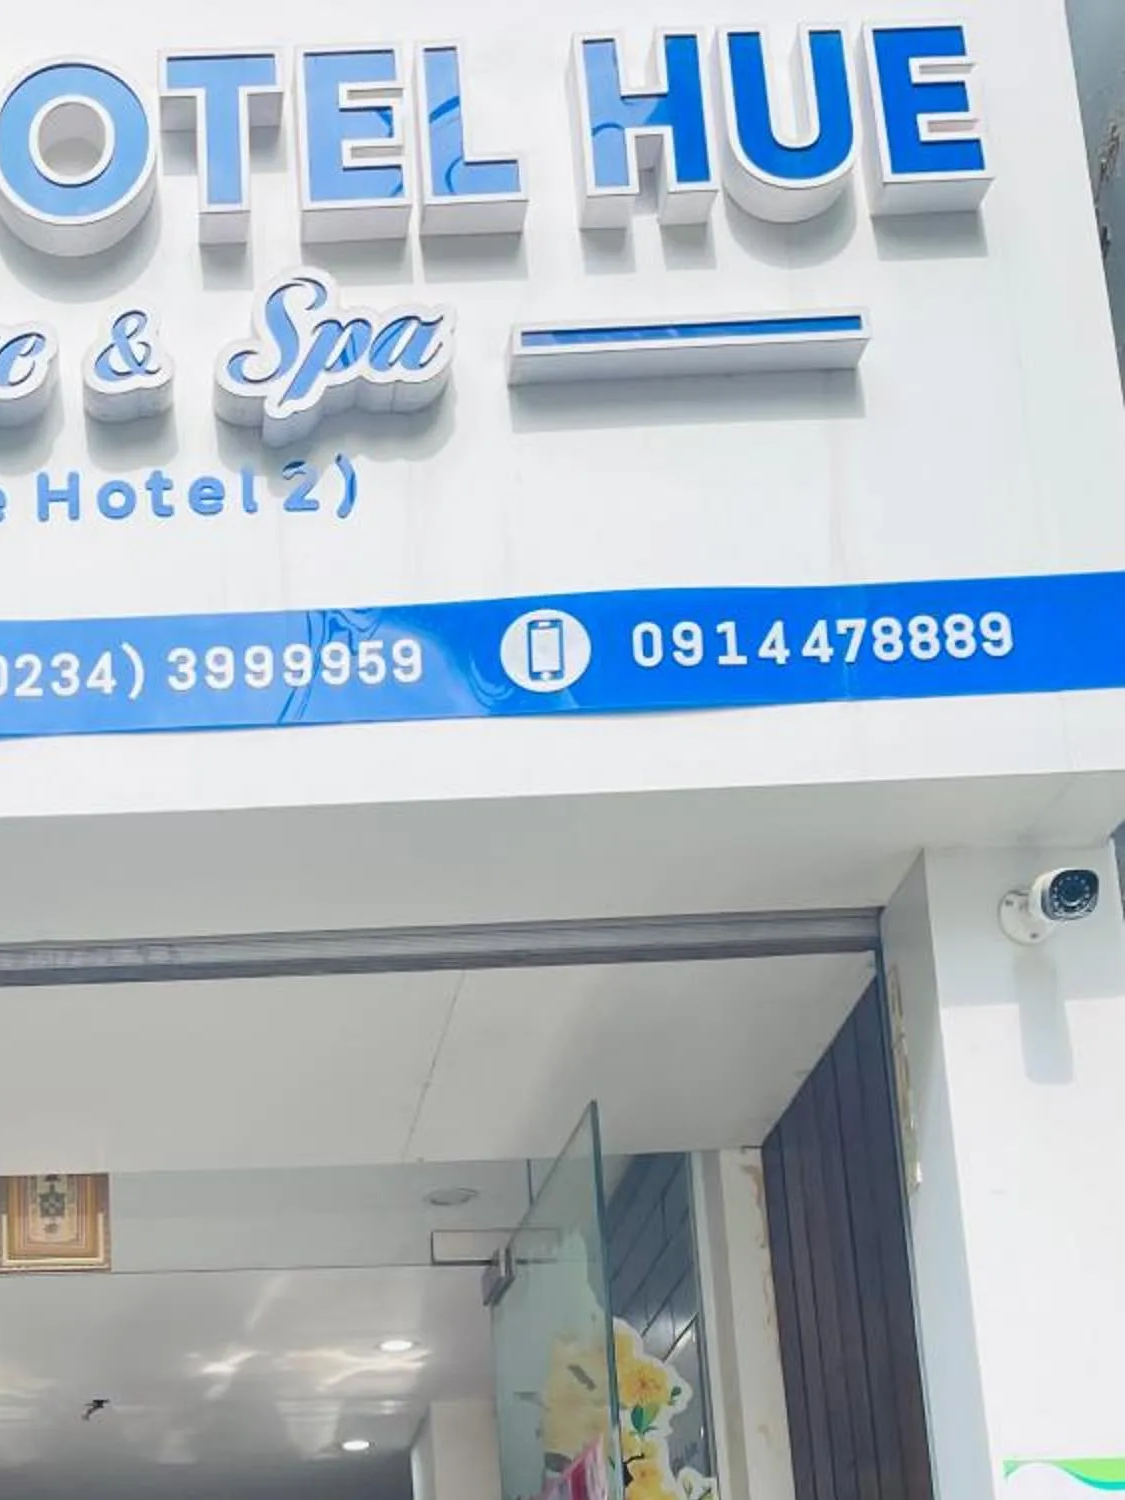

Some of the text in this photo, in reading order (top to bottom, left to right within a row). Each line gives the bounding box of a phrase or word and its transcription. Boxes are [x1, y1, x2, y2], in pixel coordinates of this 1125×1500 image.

[580, 23, 989, 190] HUE
[93, 309, 160, 383] &
[227, 276, 444, 406] Spa
[36, 466, 259, 522] Hotel
[282, 453, 357, 519] 2)
[166, 636, 424, 694] 3999959
[632, 612, 1013, 667] 0914478889
